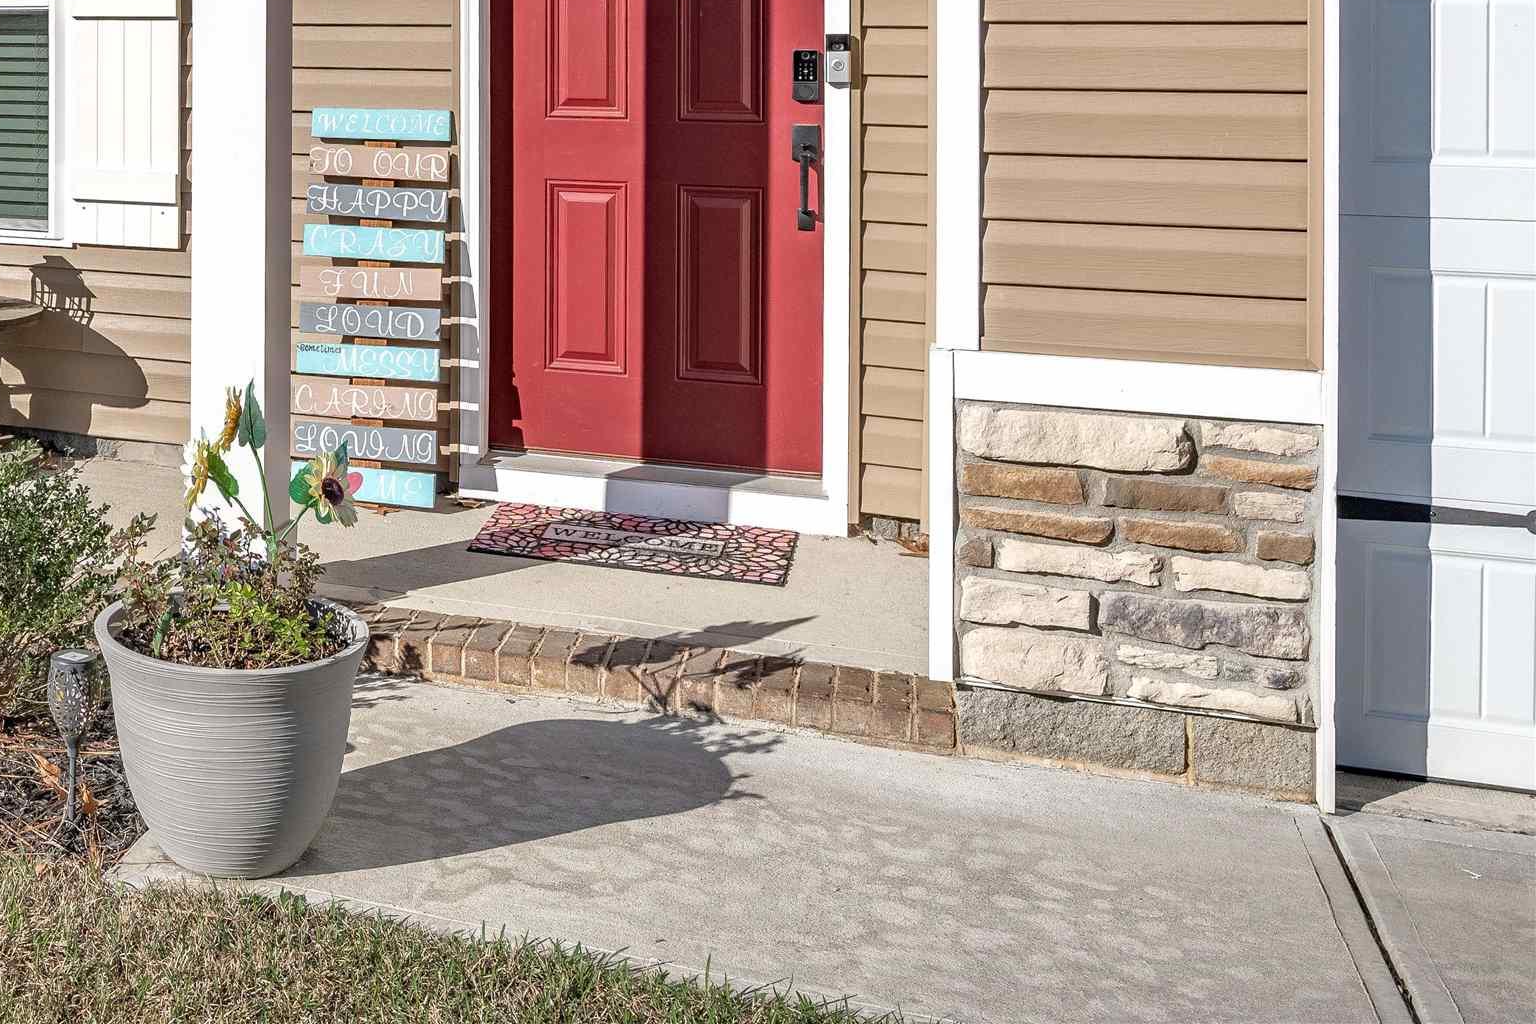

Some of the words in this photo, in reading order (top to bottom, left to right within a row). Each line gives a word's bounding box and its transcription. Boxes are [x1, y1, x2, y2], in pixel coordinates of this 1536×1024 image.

[317, 110, 448, 136] WELCOME
[309, 147, 353, 175] TO
[373, 149, 448, 181] OUR
[306, 185, 447, 222] HAPPY
[309, 225, 441, 263] CRAZY
[320, 269, 414, 298] FUN
[315, 306, 425, 338] LOUD
[323, 347, 440, 381] MESSY
[295, 384, 437, 420] CARING
[294, 424, 433, 462] LOVING
[552, 527, 719, 552] WELCOME
